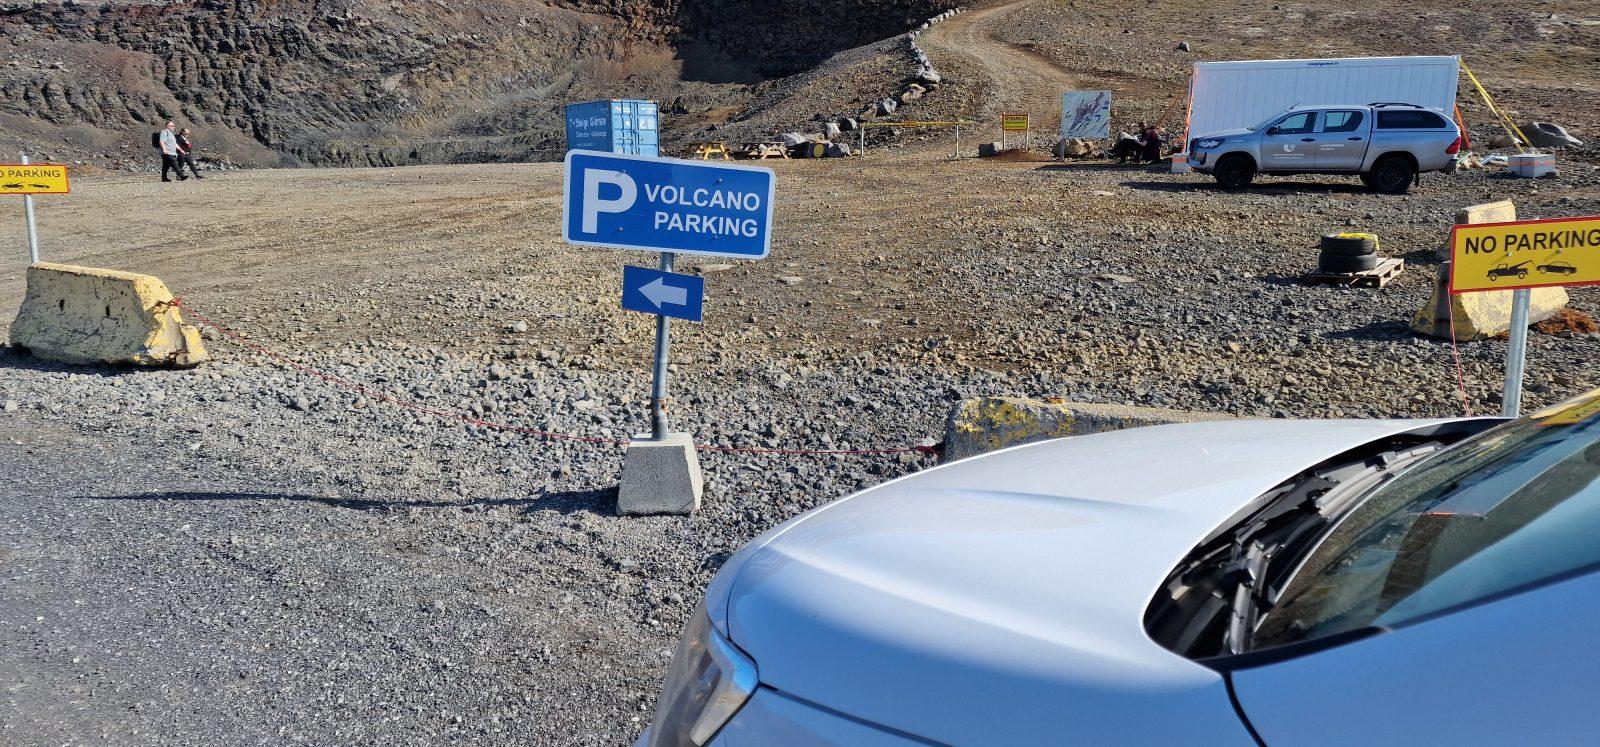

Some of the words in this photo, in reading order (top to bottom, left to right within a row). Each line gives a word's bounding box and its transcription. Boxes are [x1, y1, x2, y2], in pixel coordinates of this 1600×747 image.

[8, 169, 60, 177] PARKING
[582, 168, 637, 233] P
[644, 183, 760, 212] VOLCANO
[654, 211, 758, 238] PARKING
[1465, 235, 1497, 254] NO
[1504, 228, 1600, 251] PARKING
